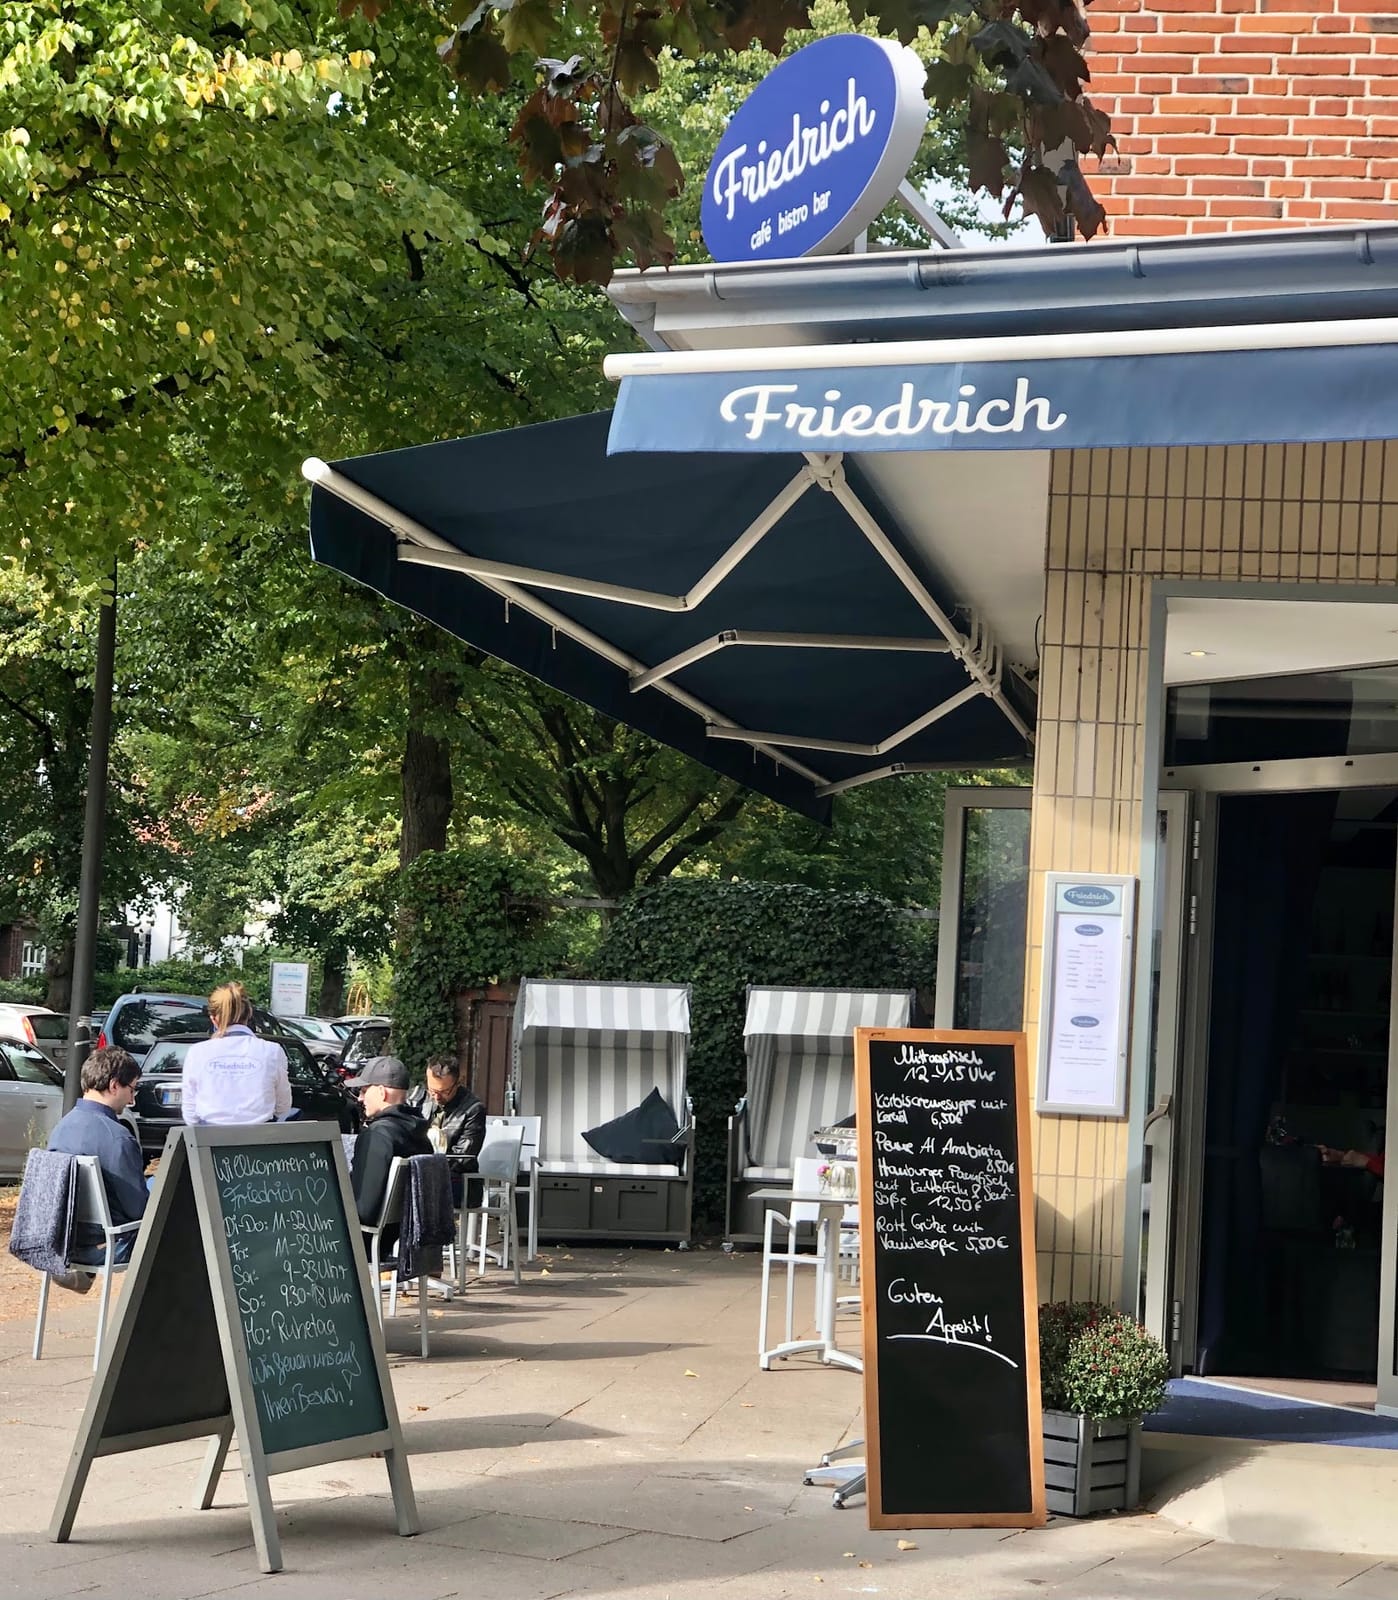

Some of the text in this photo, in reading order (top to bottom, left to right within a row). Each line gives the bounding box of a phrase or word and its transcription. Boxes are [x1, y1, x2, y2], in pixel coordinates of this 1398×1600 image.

[713, 77, 876, 221] Friedrich
[750, 189, 831, 251] café bistro bar
[720, 377, 1067, 440] Friedrich
[1067, 890, 1108, 900] Friedrich
[208, 1061, 257, 1070] Friedrich
[969, 1067, 996, 1082] Uhr
[981, 1099, 1008, 1109] mit
[931, 1111, 963, 1129] 6,50€
[919, 1137, 935, 1154] Al
[213, 1152, 329, 1183] Willkommen im
[878, 1157, 943, 1183] Hamburger
[875, 1179, 900, 1191] mit
[223, 1180, 303, 1212] Friedrich
[875, 1191, 907, 1210] Soße
[308, 1212, 335, 1232] Uhr
[876, 1211, 984, 1236] Rote Grütze mit
[313, 1234, 340, 1254] Uhr
[965, 1236, 1009, 1254] 5,50€
[318, 1258, 348, 1280] Uhr
[326, 1287, 352, 1304] Uhr
[888, 1278, 943, 1304] Guten
[271, 1310, 339, 1347] Ruhetag
